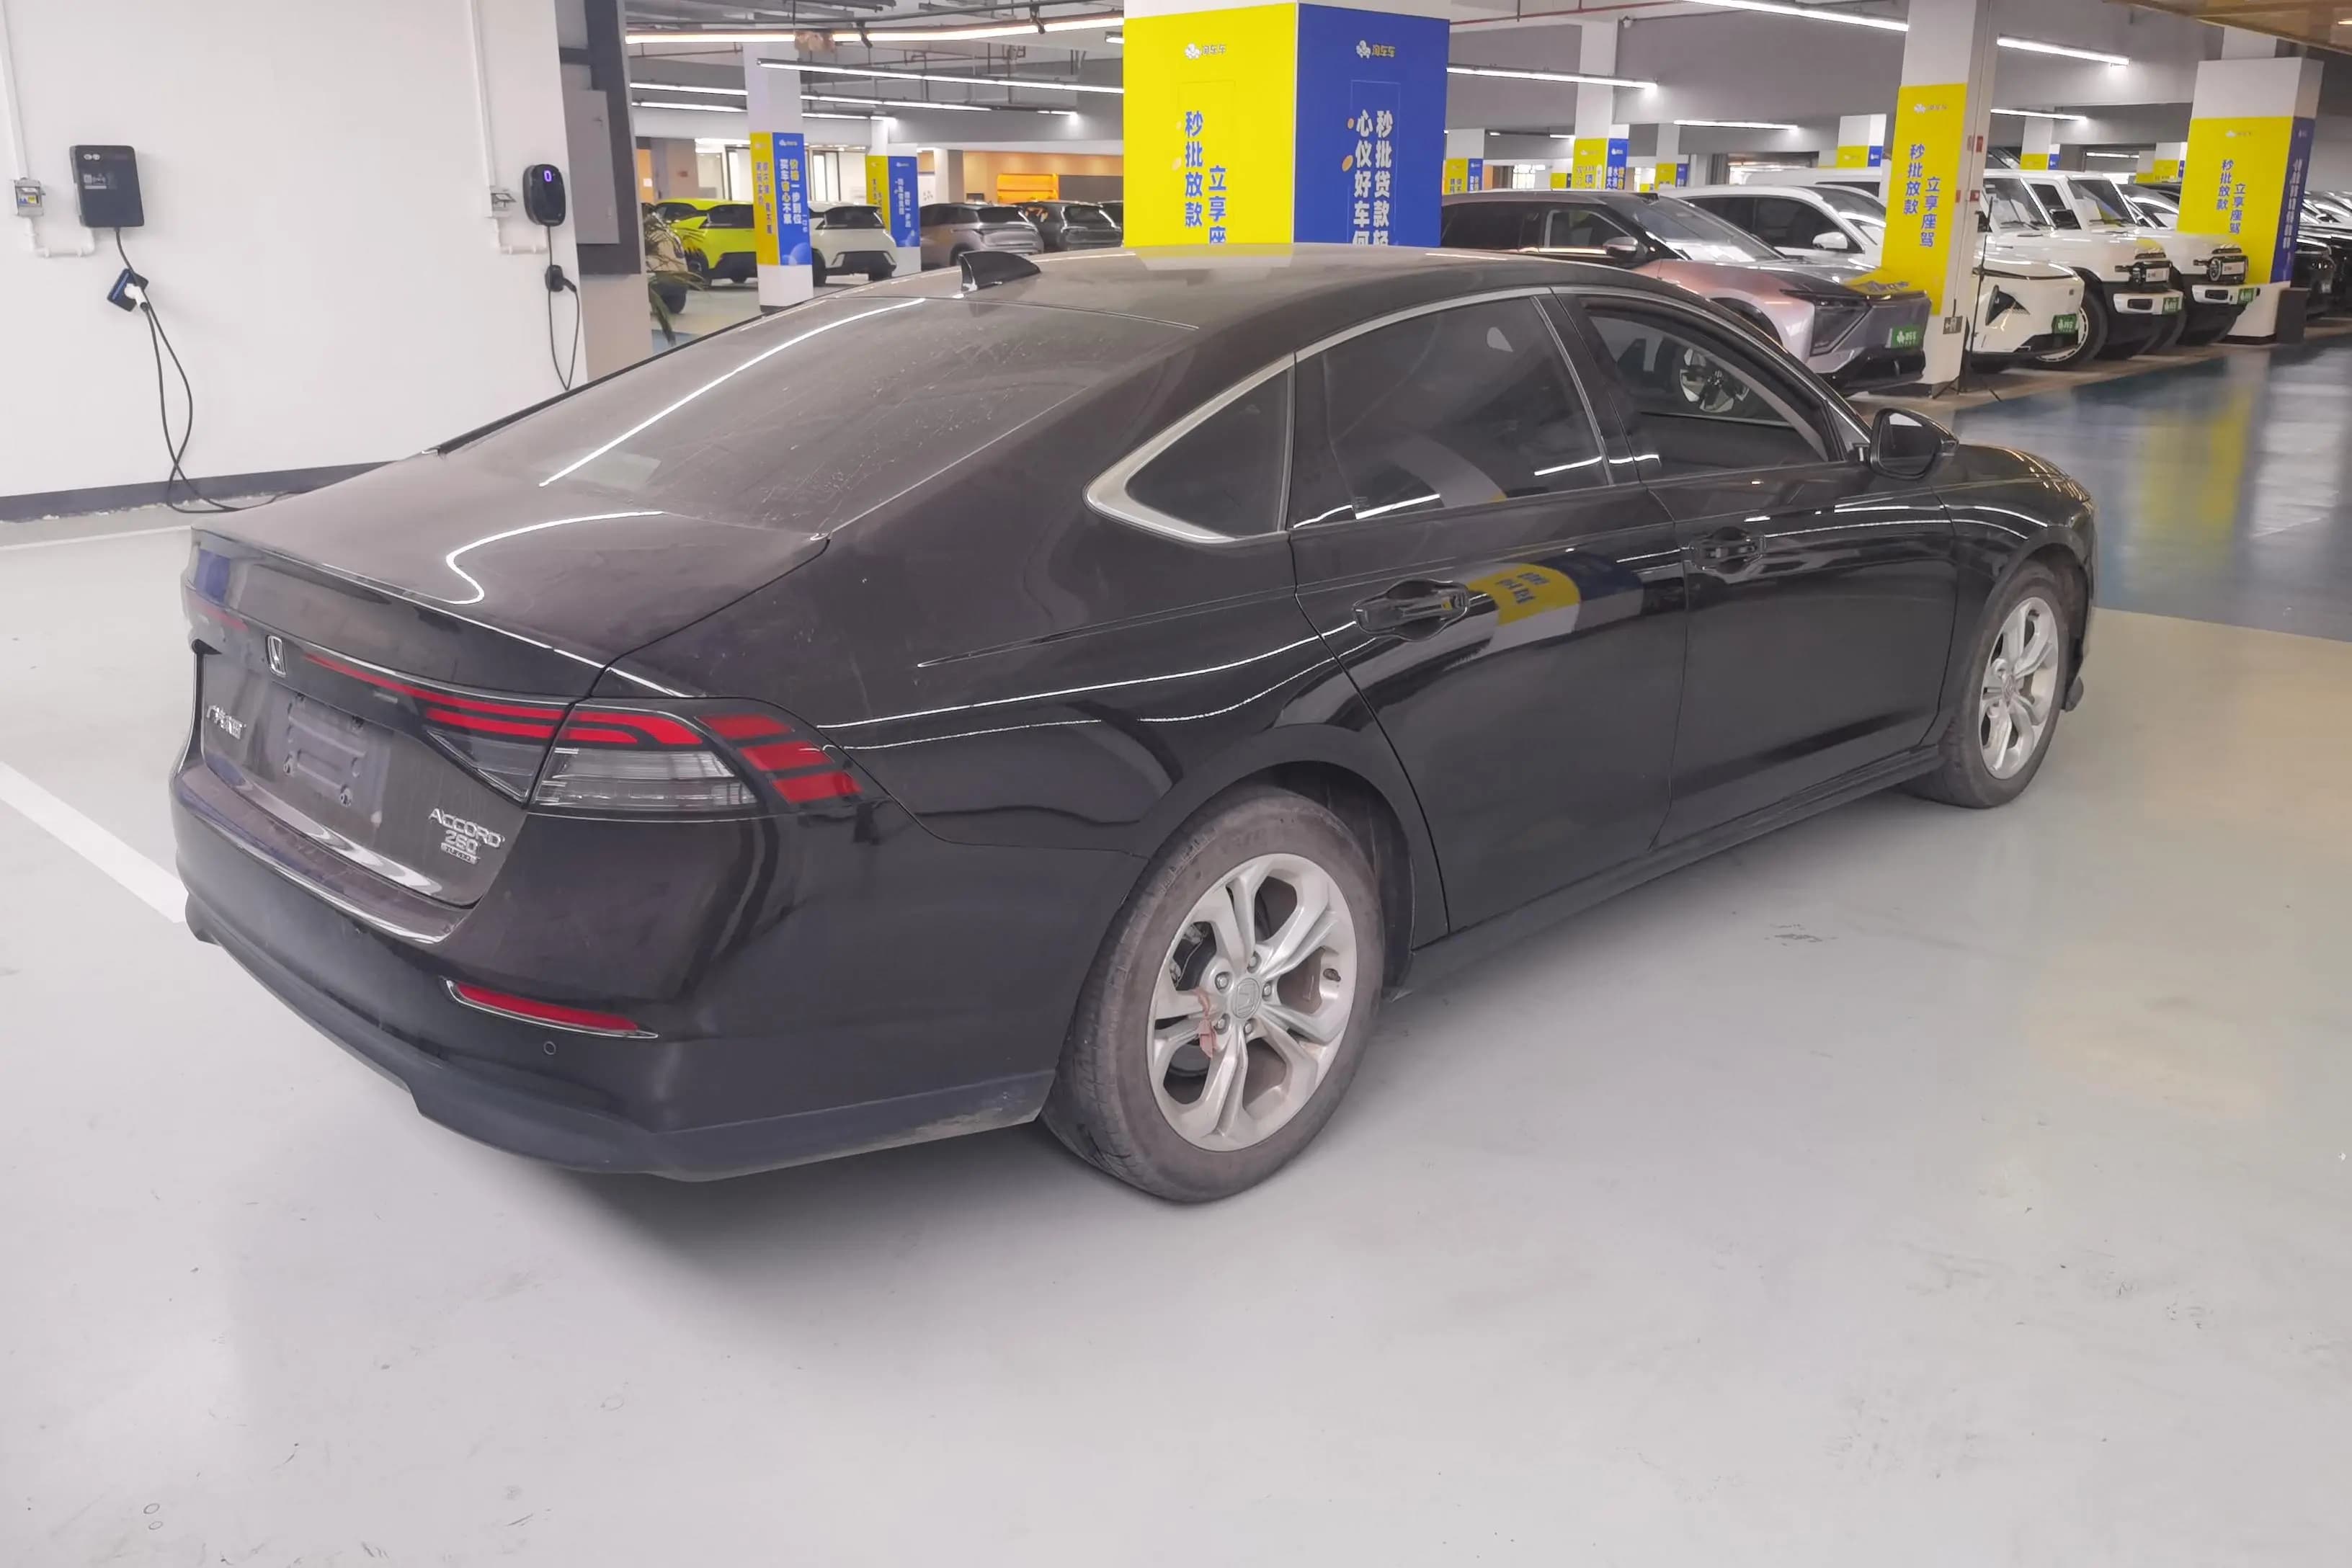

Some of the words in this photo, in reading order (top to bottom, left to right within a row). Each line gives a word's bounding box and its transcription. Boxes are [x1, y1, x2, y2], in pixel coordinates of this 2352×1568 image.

[1185, 110, 1203, 228] 秒批放款
[1208, 165, 1226, 244] 立享座
[1903, 143, 1925, 215] 秒批放款
[1920, 177, 1941, 247] 立享座驾
[428, 808, 502, 848] ACCORD
[445, 829, 478, 855] 260
